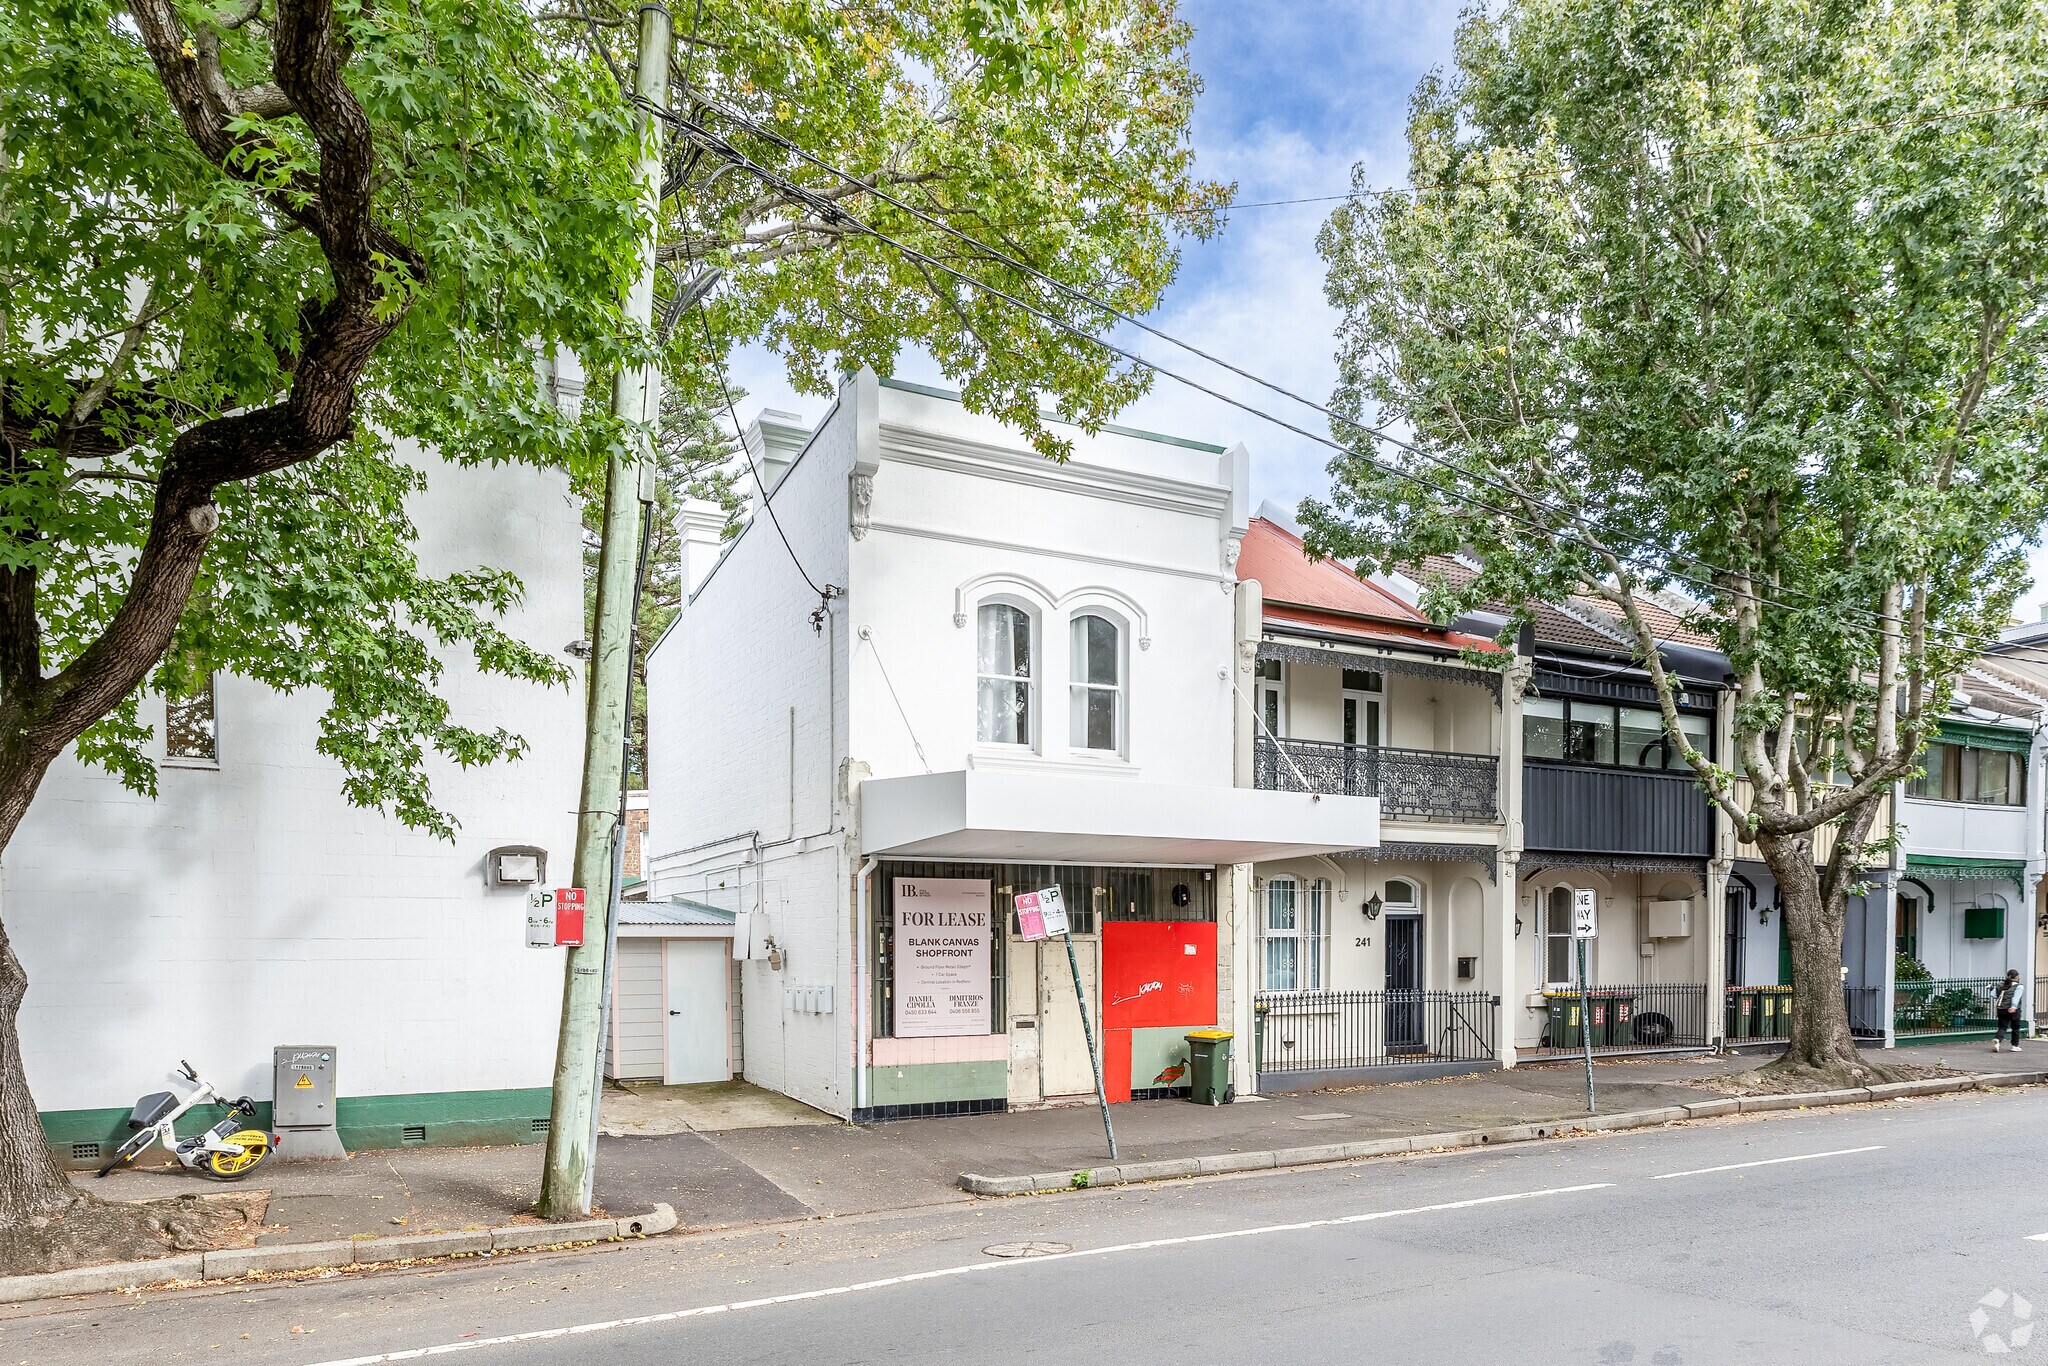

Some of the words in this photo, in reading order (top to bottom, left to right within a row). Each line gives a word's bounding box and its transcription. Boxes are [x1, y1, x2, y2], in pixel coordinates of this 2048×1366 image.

[565, 891, 577, 901] NO
[1022, 897, 1033, 905] NO
[557, 902, 584, 911] STOPPING
[901, 911, 935, 927] FOR
[938, 912, 986, 927] LEASE
[908, 938, 941, 946] BLANK
[942, 938, 980, 946] CANVAS
[1355, 937, 1371, 947] 241
[915, 949, 973, 957] SHOPFRONT
[908, 995, 934, 1003] DANIEL
[949, 994, 984, 1002] DIMITRIOS
